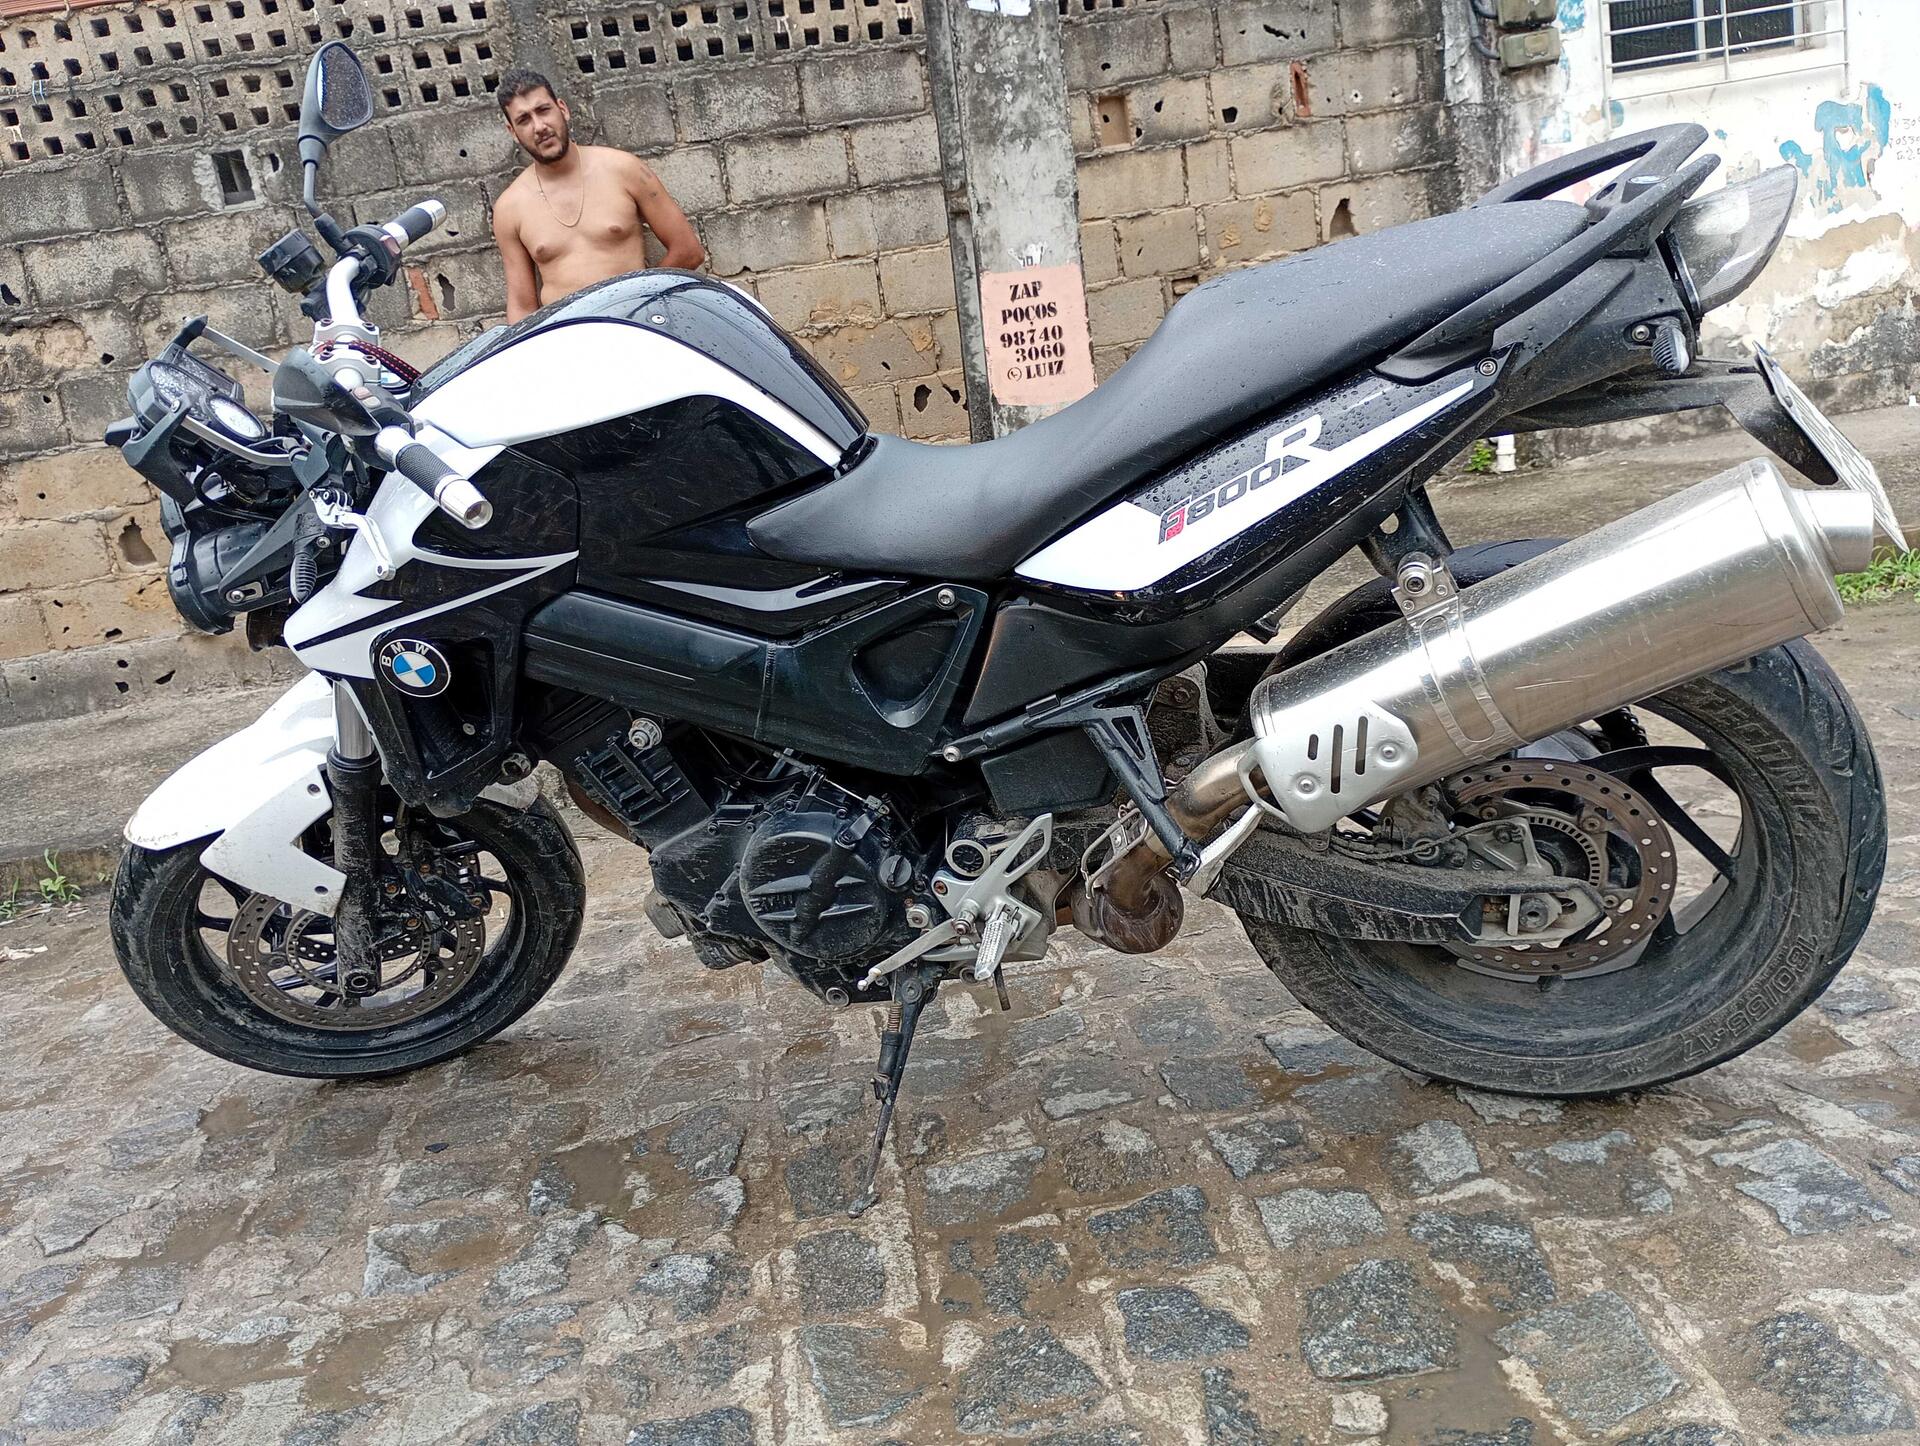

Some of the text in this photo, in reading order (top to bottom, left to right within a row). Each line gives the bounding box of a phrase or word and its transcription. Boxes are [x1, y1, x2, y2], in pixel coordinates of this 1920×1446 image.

[1010, 281, 1041, 302] ZAP
[1001, 302, 1057, 325] POÇOS
[1000, 325, 1063, 348] 98740
[1015, 342, 1066, 363] 3060
[1026, 360, 1064, 379] LUIZ
[381, 641, 430, 668] BMW
